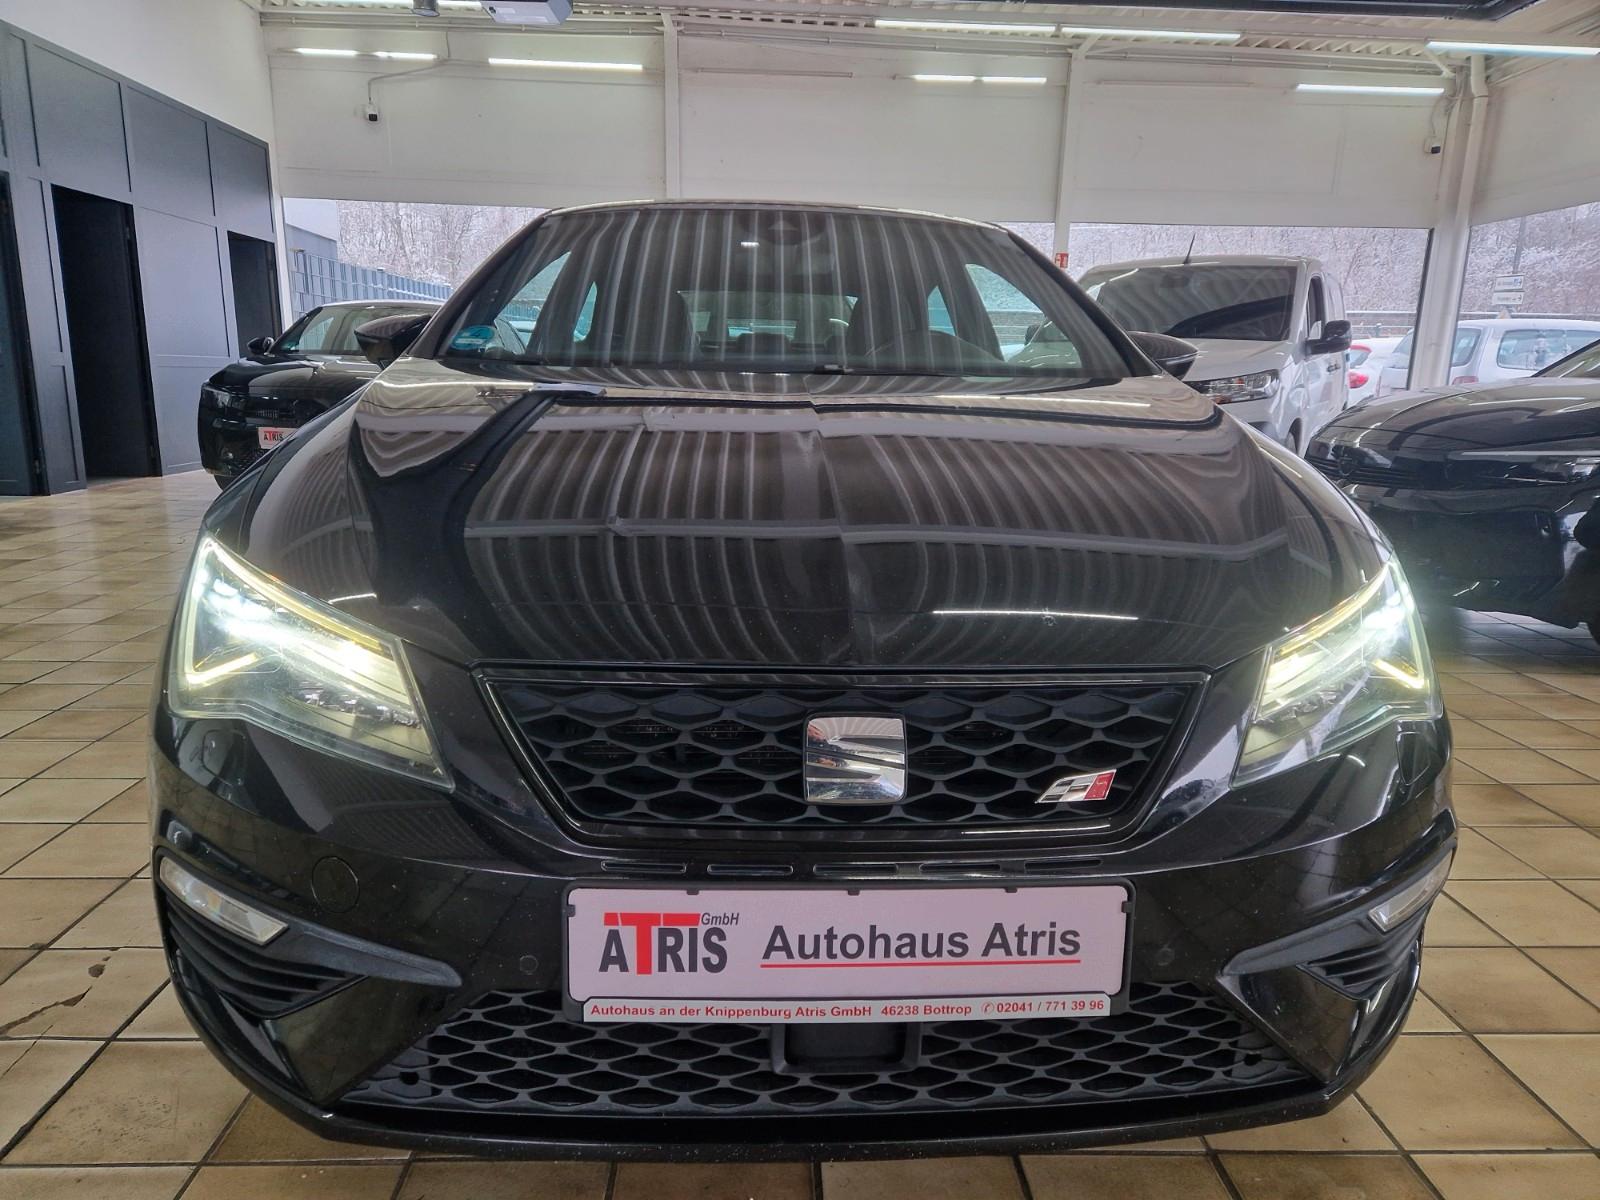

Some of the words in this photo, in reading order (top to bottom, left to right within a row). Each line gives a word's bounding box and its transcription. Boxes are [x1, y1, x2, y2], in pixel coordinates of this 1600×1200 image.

[598, 912, 728, 975] ATRIS
[701, 912, 739, 926] GmbH
[761, 924, 969, 960] Autohaus
[981, 921, 1081, 958] Atris
[591, 1004, 655, 1016] Autohaus
[659, 1006, 675, 1016] an
[680, 1006, 700, 1017] der
[705, 1006, 792, 1019] Knippenburg
[795, 1006, 826, 1017] Atris
[831, 1006, 872, 1017] GmbH
[881, 1005, 919, 1016] 46238
[923, 1004, 972, 1017] Bottrop
[997, 1002, 1033, 1013] 02041
[1045, 1001, 1067, 1012] 771
[1071, 1000, 1086, 1011] 39
[1089, 999, 1104, 1010] 96
